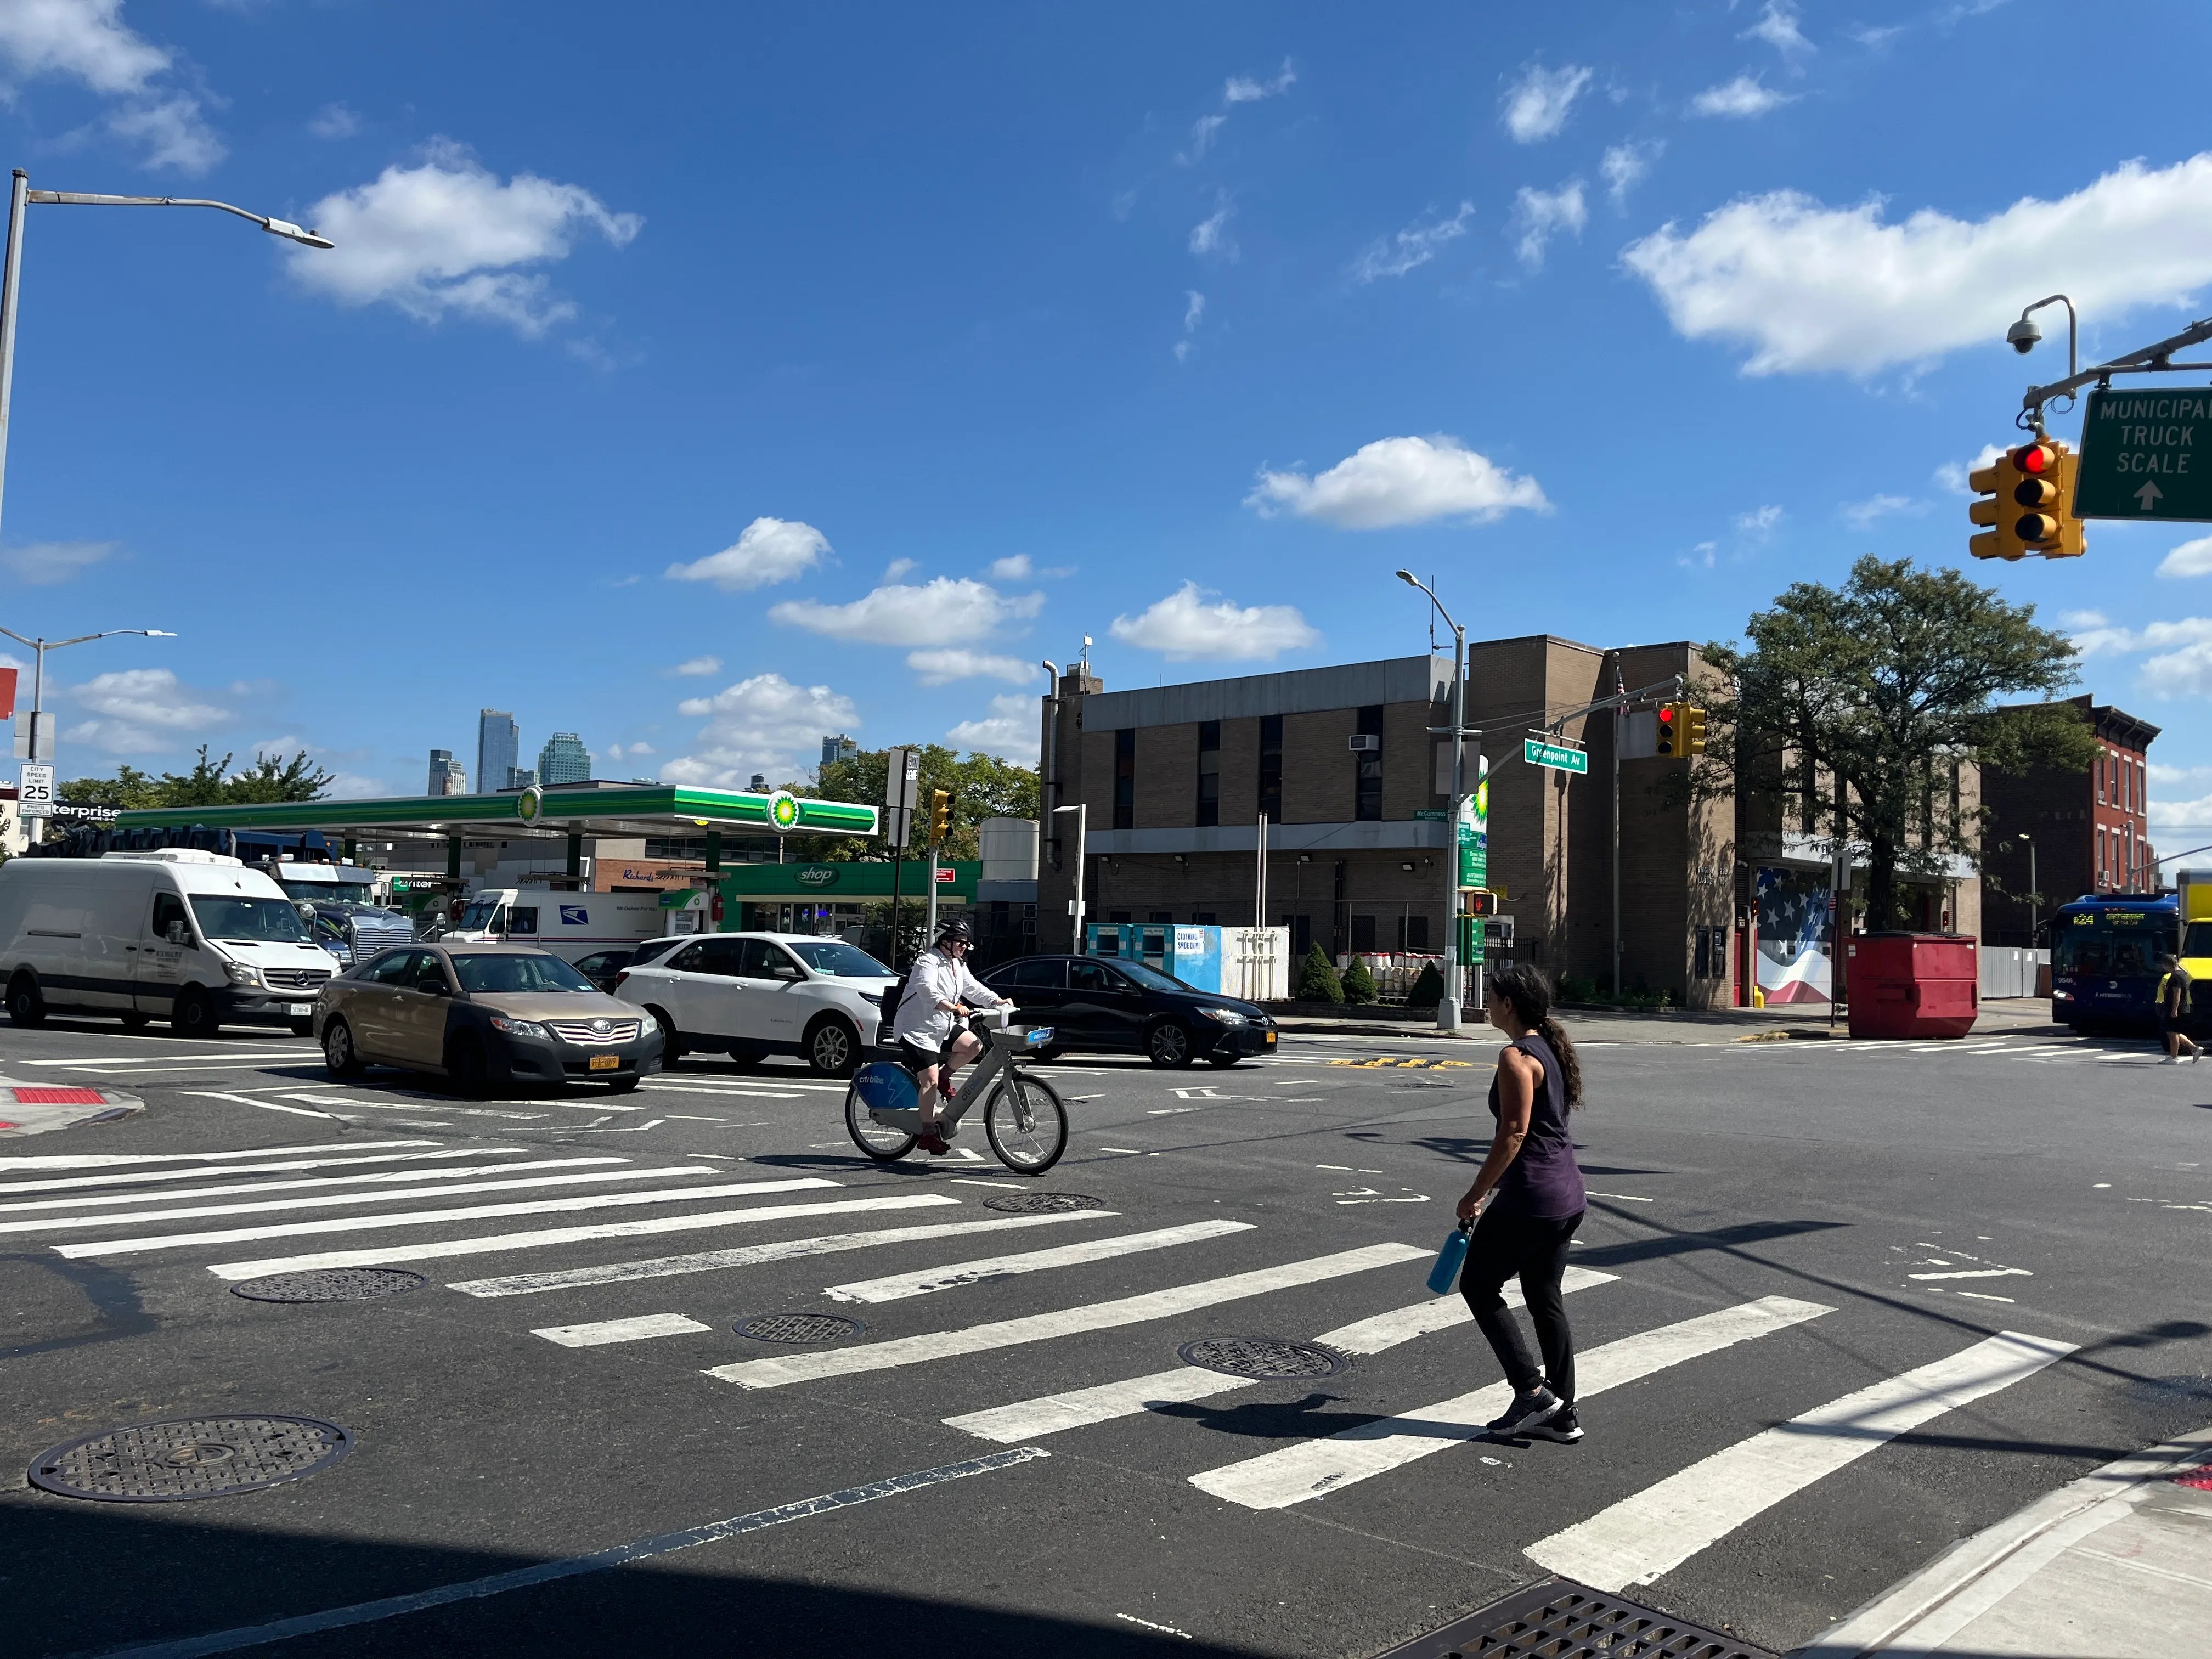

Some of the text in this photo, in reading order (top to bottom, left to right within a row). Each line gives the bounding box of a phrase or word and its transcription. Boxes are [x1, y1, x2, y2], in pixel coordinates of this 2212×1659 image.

[2100, 399, 2212, 419] MUNICIPA
[2121, 426, 2194, 446] TRUCK
[2117, 452, 2191, 473] SCALE
[1531, 744, 1581, 765] Greenpoint Av
[24, 785, 49, 799] 25
[53, 804, 121, 818] terprise
[623, 870, 654, 882] Richards
[802, 866, 832, 884] shop
